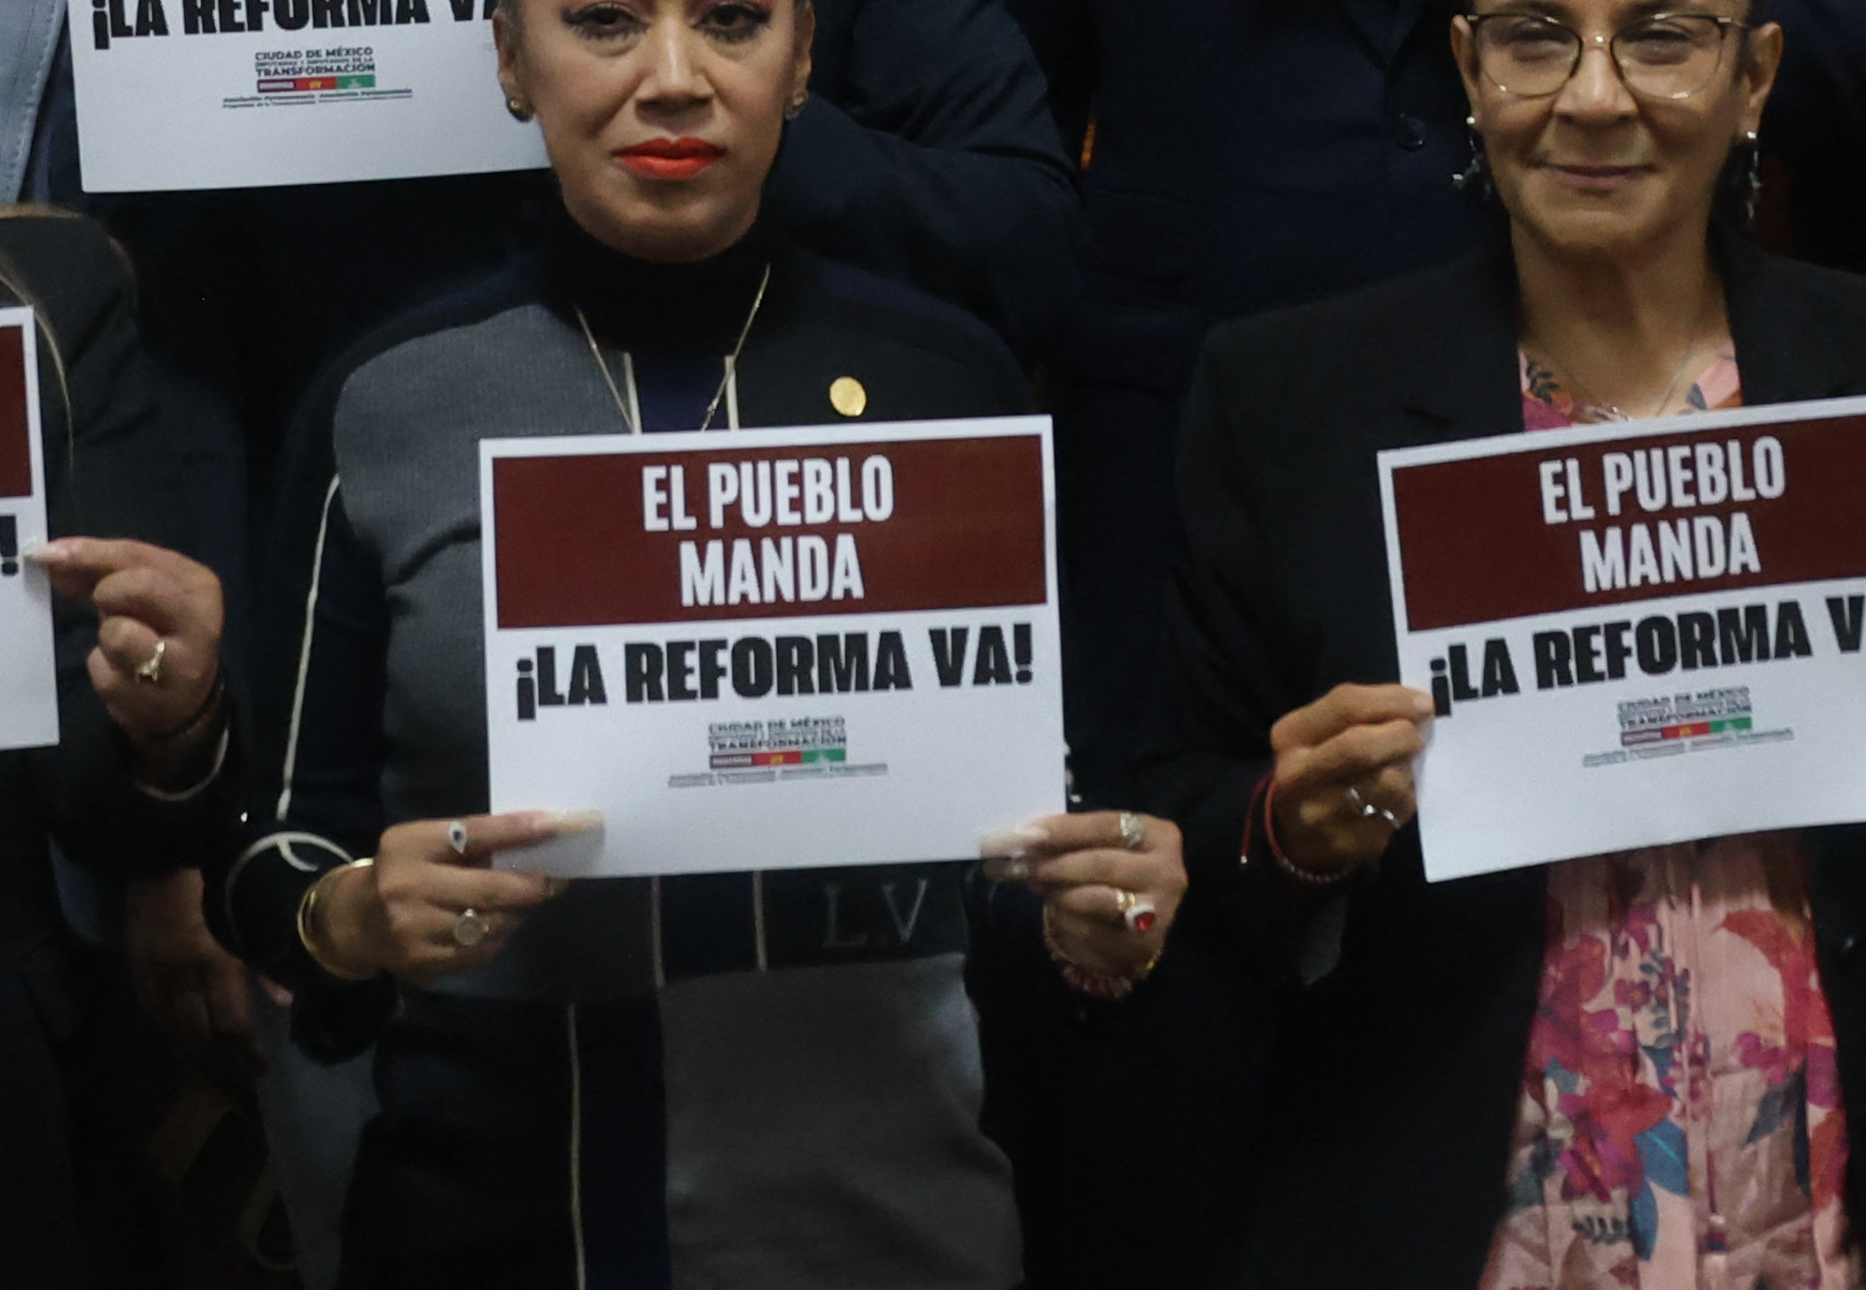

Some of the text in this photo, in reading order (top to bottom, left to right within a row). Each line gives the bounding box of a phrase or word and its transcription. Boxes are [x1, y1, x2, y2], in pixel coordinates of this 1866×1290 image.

[643, 455, 893, 531] EL PUEBLO
[1540, 437, 1784, 524] EL PUEBLO
[680, 534, 863, 606] MANDA
[1580, 513, 1760, 592] MANDA
[517, 623, 1032, 720] ¡LA REFORMA VA!
[1429, 638, 1519, 718] ¡LA
[1533, 601, 1812, 689] REFORMA
